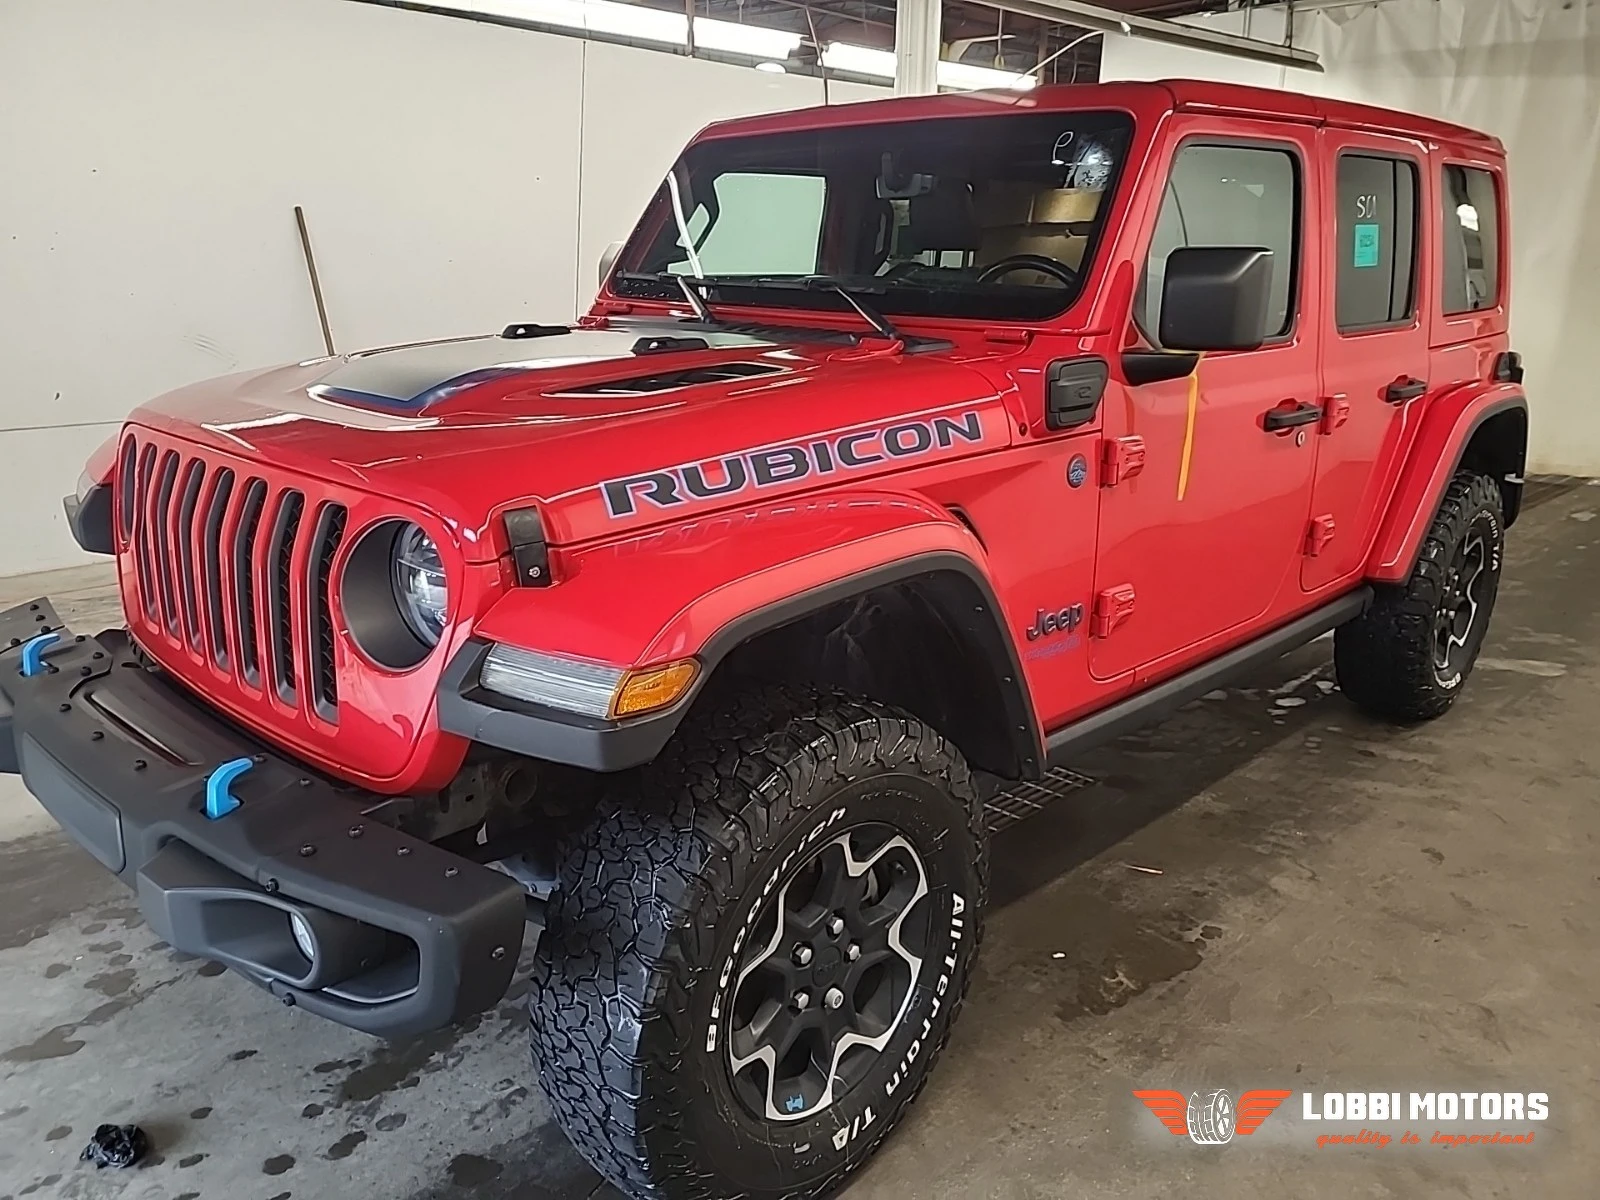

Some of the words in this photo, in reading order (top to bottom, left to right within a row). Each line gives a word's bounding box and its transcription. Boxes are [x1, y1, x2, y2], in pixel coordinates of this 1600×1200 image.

[600, 411, 983, 519] RUBICON
[1026, 602, 1083, 641] Jeep
[706, 807, 846, 1052] BFGoodrich
[885, 893, 966, 1097] All-Terrain
[831, 1106, 877, 1151] T/A
